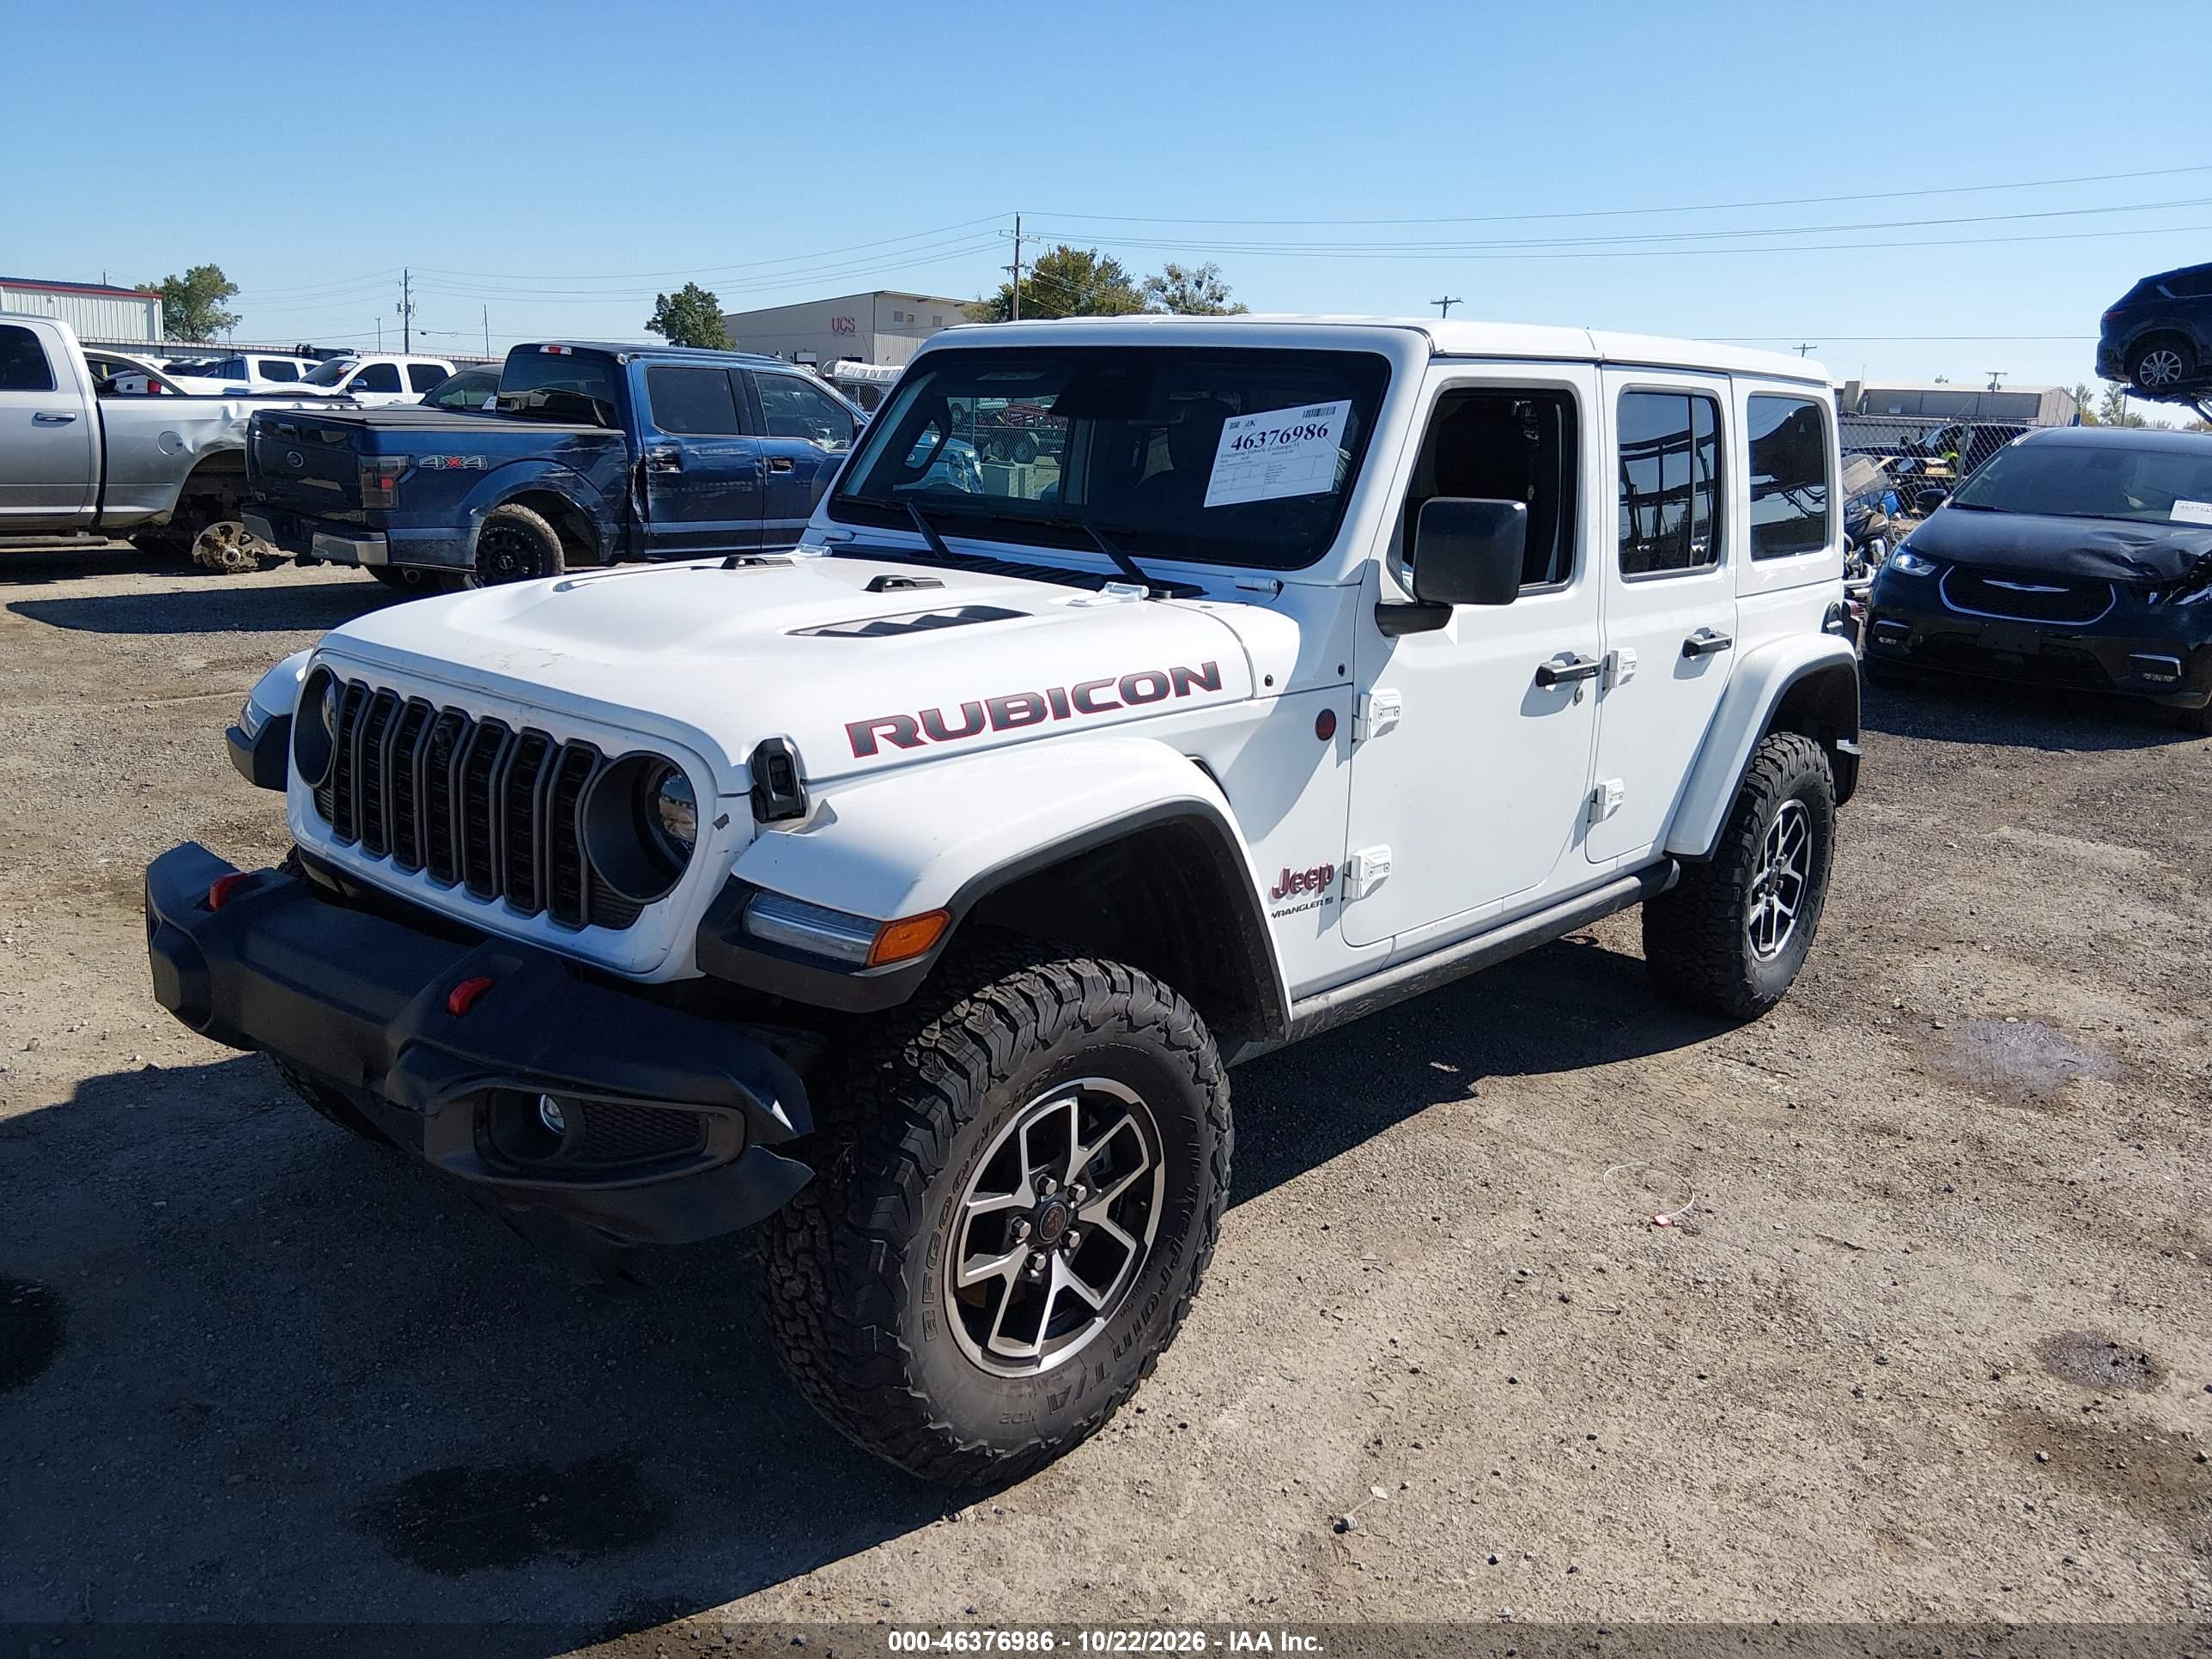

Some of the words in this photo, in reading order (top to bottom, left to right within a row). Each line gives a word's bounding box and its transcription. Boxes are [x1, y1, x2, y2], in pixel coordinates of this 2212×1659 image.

[831, 316, 855, 332] UCS
[1231, 421, 1331, 452] 46376986
[844, 661, 1223, 758] RUBICON
[1271, 863, 1334, 899] Jeep
